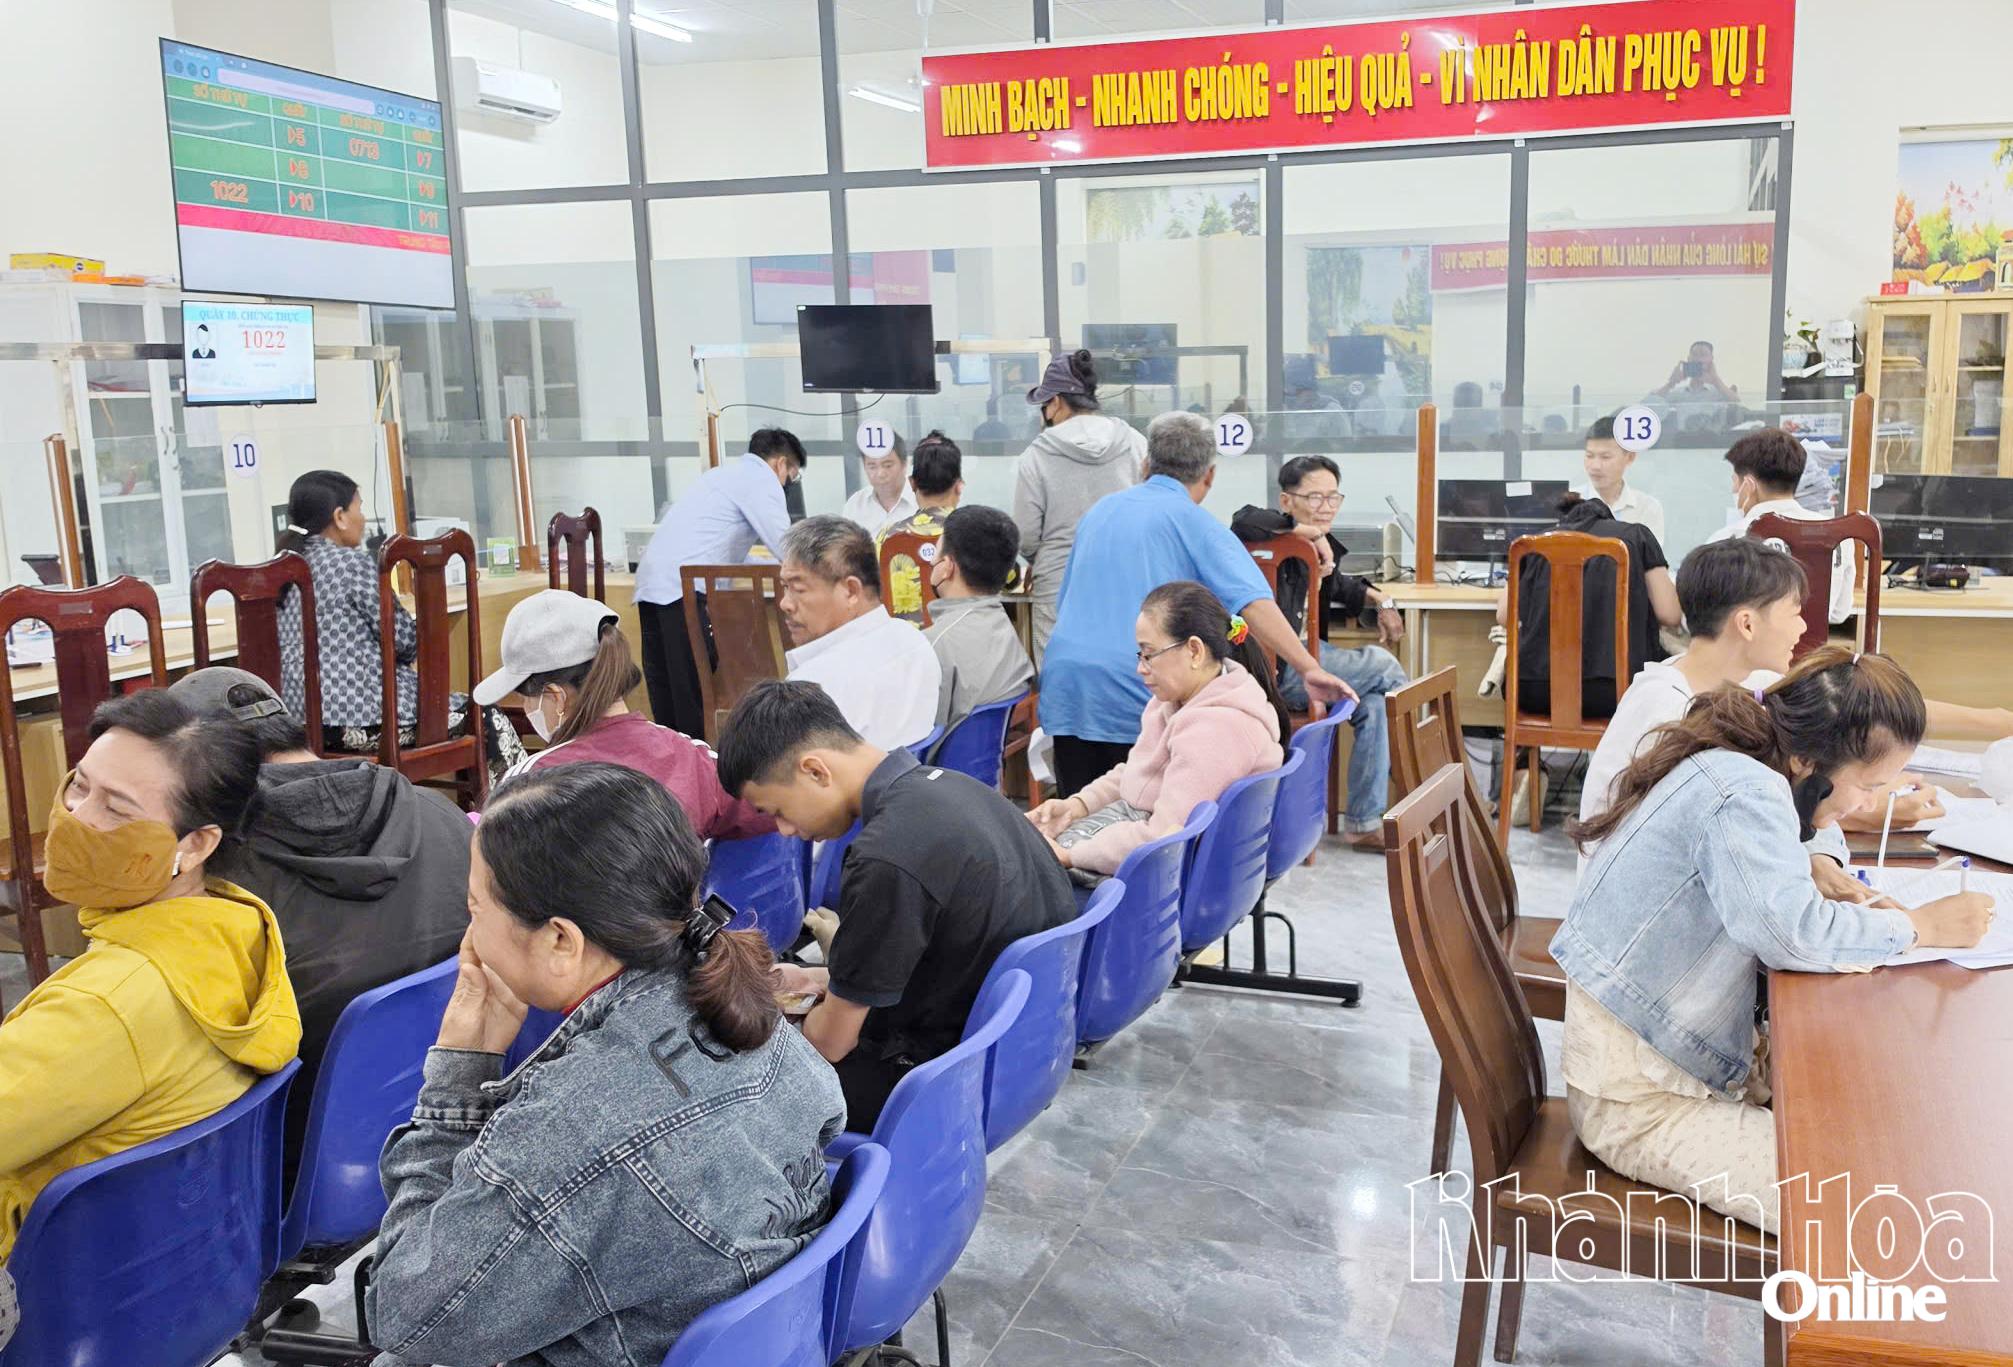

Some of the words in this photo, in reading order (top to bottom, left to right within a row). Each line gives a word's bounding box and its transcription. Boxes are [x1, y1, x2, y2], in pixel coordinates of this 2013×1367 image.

[941, 82, 1002, 137] MINH
[1007, 77, 1070, 140] BẠCH
[1075, 96, 1087, 107] -
[1093, 69, 1178, 128] NHANH
[1184, 52, 1269, 122] CHÓNG
[1276, 82, 1288, 93] -
[1294, 44, 1353, 123] HIỆU
[1360, 31, 1413, 116] QUẢ
[1419, 73, 1432, 84] -
[1440, 36, 1466, 105] VÌ
[1473, 29, 1551, 102] NHÂN
[1557, 23, 1617, 96] DÂN
[1623, 28, 1701, 101] PHỤC
[210, 180, 248, 203] 1022
[243, 329, 286, 349] 1022
[866, 427, 886, 448] 11
[1220, 424, 1244, 446] 12
[1623, 416, 1652, 440] 13
[233, 443, 256, 468] 10
